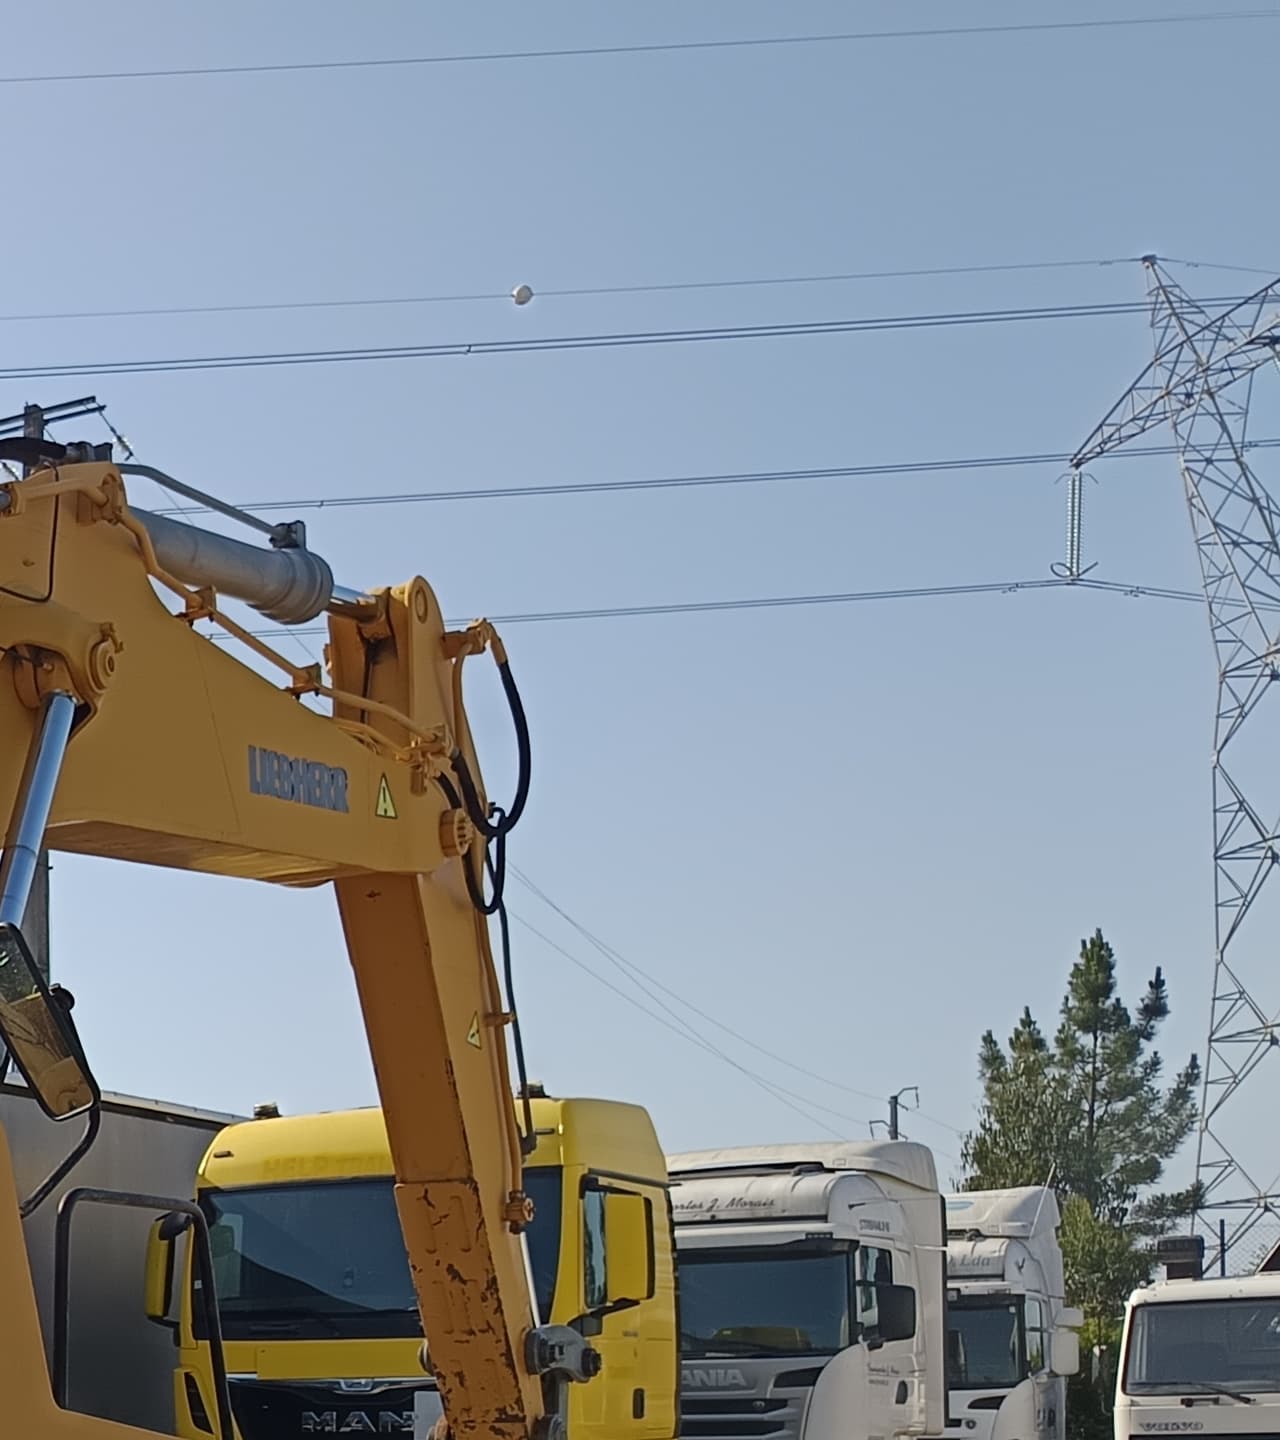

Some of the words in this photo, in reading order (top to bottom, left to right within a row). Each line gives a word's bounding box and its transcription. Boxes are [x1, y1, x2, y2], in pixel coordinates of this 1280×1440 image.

[247, 744, 349, 813] LIEBHERR
[681, 1368, 747, 1387] ANIA
[301, 1411, 415, 1432] MAN
